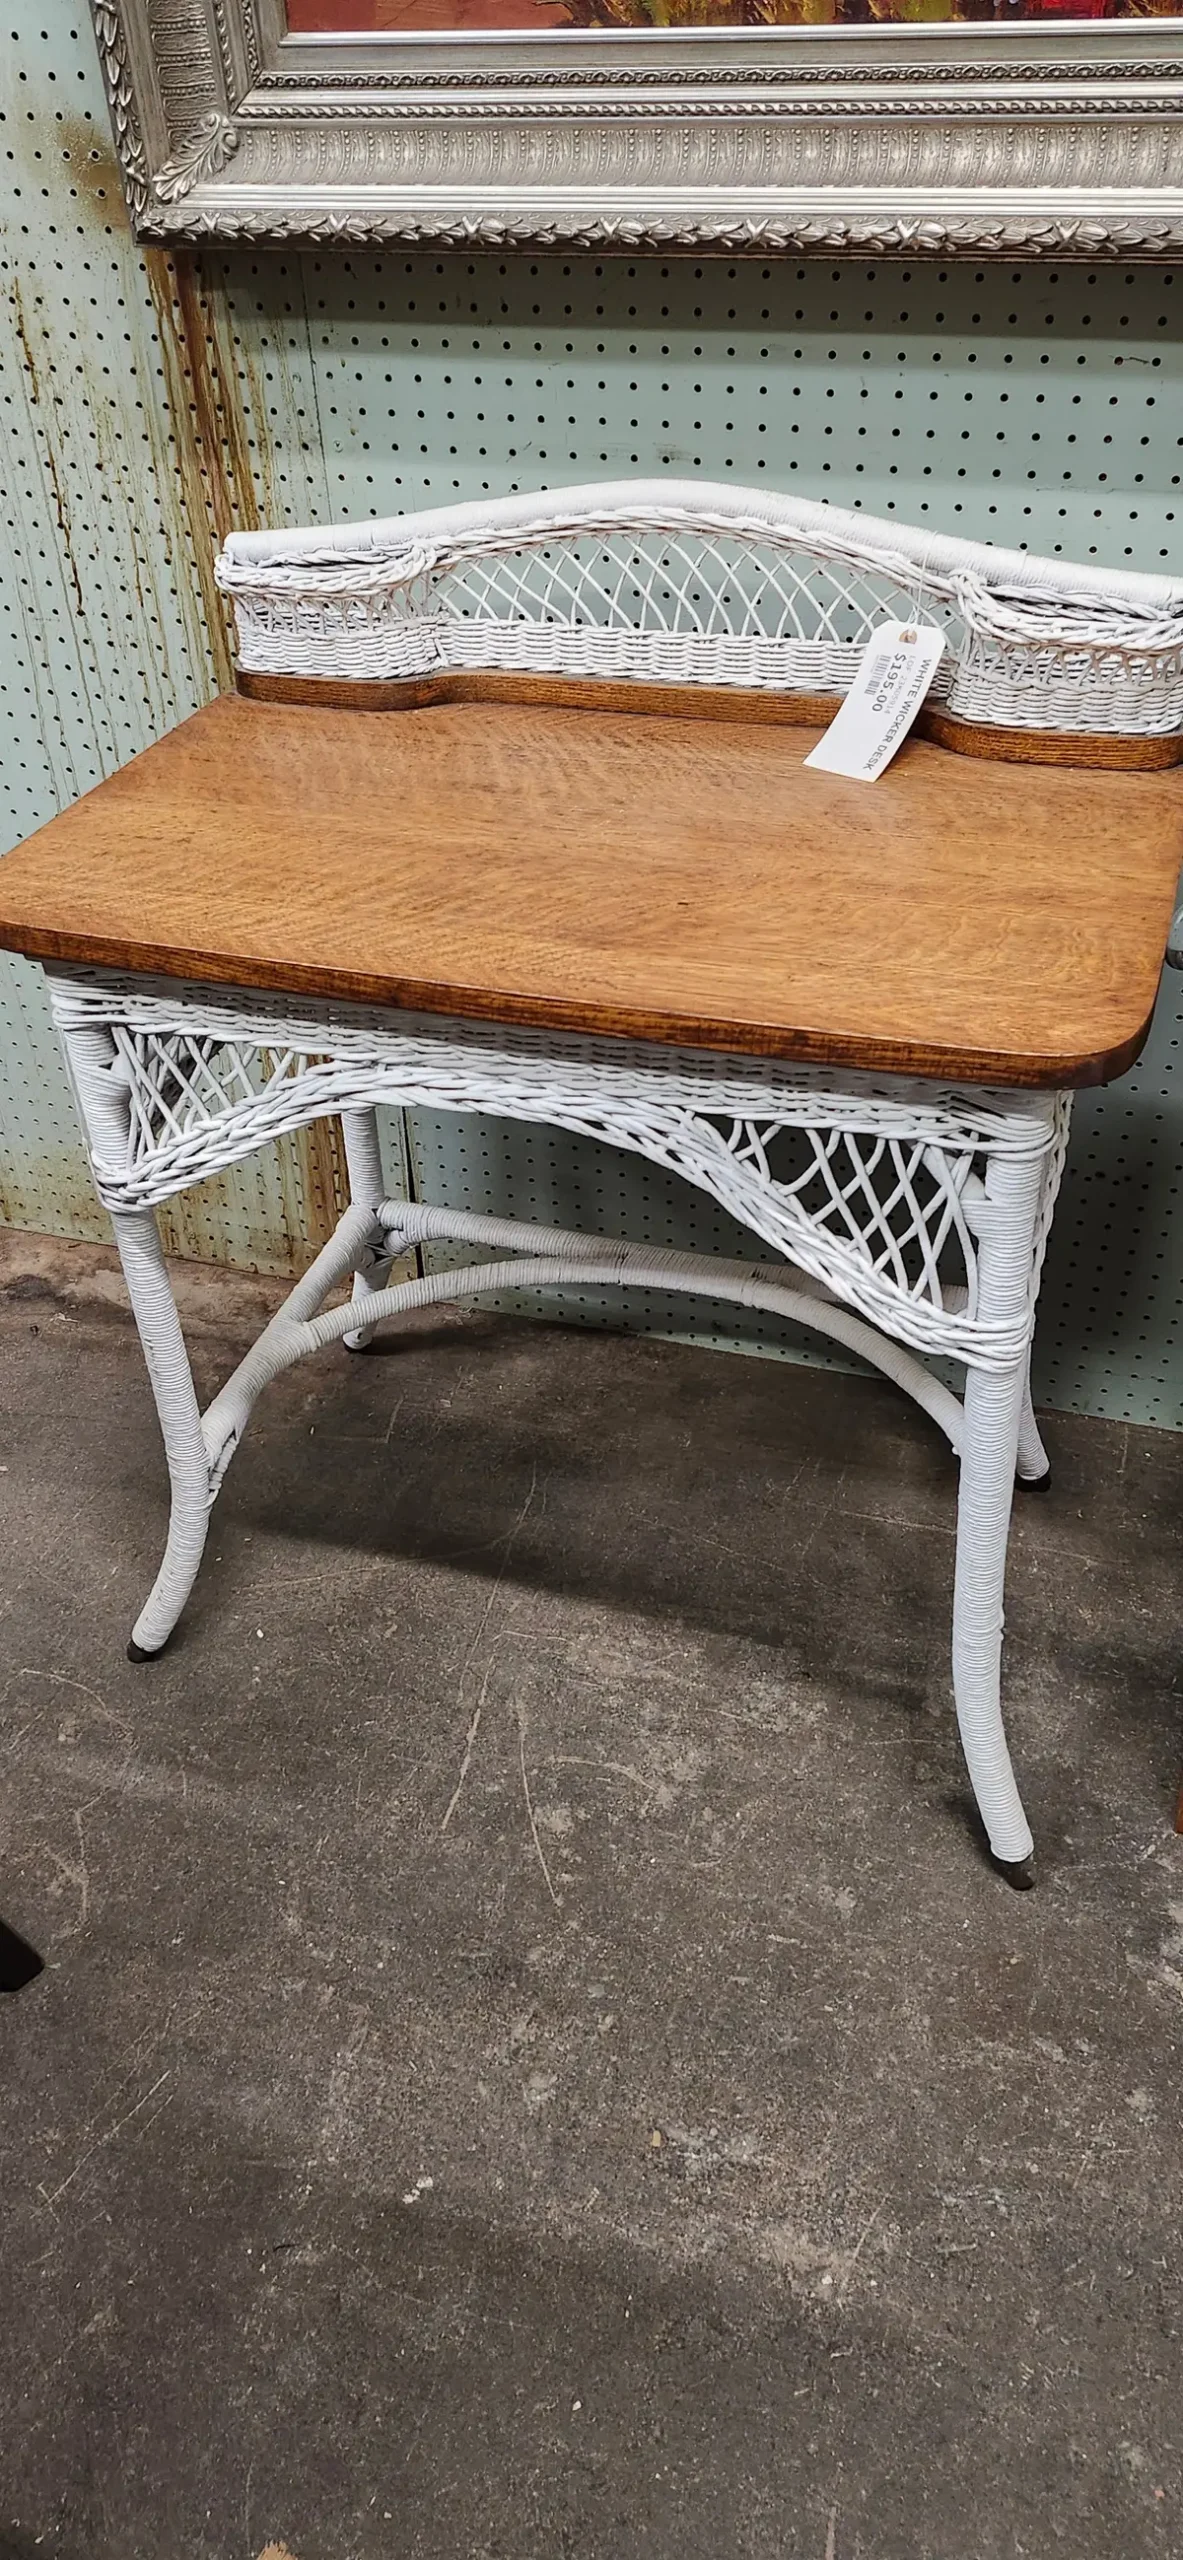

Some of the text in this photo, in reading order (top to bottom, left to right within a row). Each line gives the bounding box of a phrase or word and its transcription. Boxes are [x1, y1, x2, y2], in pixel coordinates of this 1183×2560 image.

[863, 659, 932, 771] WHITE WICKER DESK
[872, 653, 907, 712] $195.00
